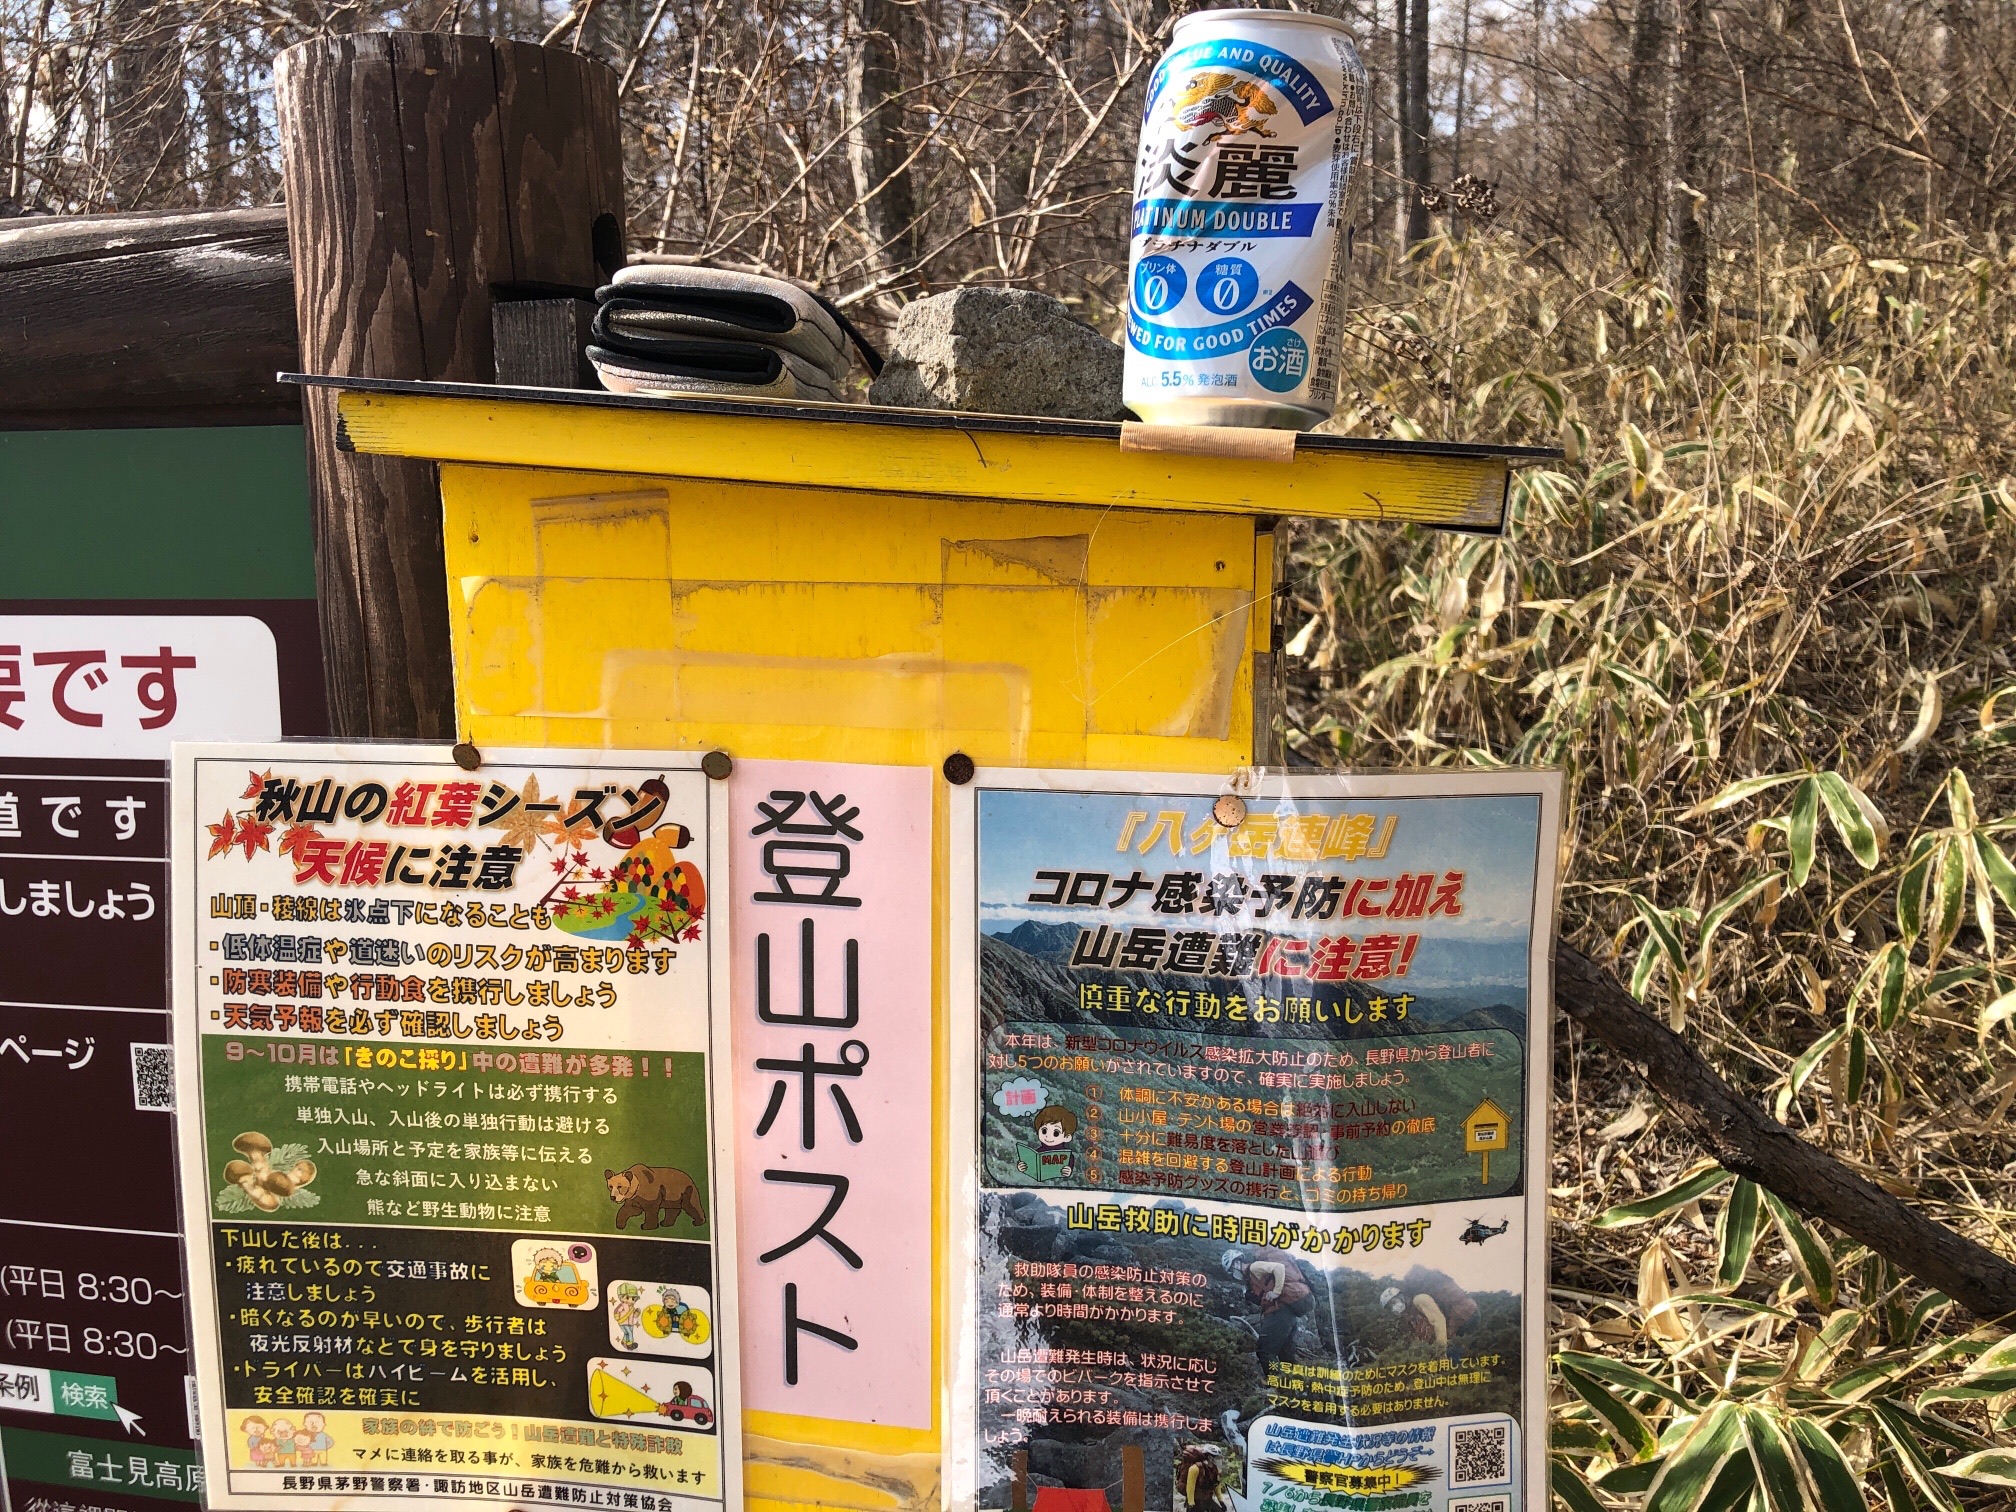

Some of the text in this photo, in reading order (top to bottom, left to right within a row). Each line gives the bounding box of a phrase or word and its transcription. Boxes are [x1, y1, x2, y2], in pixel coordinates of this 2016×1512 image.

[1217, 46, 1254, 62] AND
[1259, 56, 1322, 111] QUALITY
[1138, 138, 1299, 199] 淡麗
[1213, 210, 1293, 231] DOUBLE
[1140, 261, 1242, 276] プリン体 糖質
[1154, 334, 1187, 352] FOR
[1193, 329, 1244, 351] GOOD
[1250, 294, 1297, 336] TIMES
[1286, 337, 1302, 347] さけ
[1251, 345, 1304, 377] お酒
[1161, 370, 1195, 388] 5.5%
[1197, 373, 1238, 388] 発泡酒
[256, 778, 661, 831] 秋山の紅葉シーズン
[294, 840, 523, 891] 天候に注意
[1028, 870, 1464, 920] コロナ感染予防に加え
[210, 893, 551, 930] 山頂・稜線は氷点下になることも
[1071, 925, 1419, 981] 山岳遭難に注意!
[1079, 983, 1416, 1024] 慎重な行動をお願いします
[284, 1075, 618, 1104] 携帯電話やヘッドライトは必ず携行する
[752, 790, 870, 1386] 登山ポスト
[1004, 1088, 1037, 1106] 計画
[317, 1138, 593, 1165] 入山場所と予定を家族等に伝える
[1041, 1154, 1068, 1165] MAP
[355, 1168, 558, 1192] 急な斜面に入り込まない
[366, 1198, 552, 1223] 熊など野生動物に注意
[1067, 1202, 1431, 1254] 山岳救助に時間がかかります
[1013, 1262, 1207, 1288] 救助隊員の感染防止対策の
[246, 1282, 377, 1303] 注意しましょう
[998, 1303, 1184, 1325] 通常より時間がかかります。
[249, 1334, 567, 1363] 夜光反射材などで身を守りましょう
[984, 1369, 1215, 1394] その場でのビバークを指示させて
[61, 1381, 109, 1410] 検索
[253, 1385, 421, 1407] 安全確認を確実に
[984, 1389, 1120, 1405] 頂くことがあります。
[1000, 1408, 1214, 1433] 一晩耐えられる装備は携行しま
